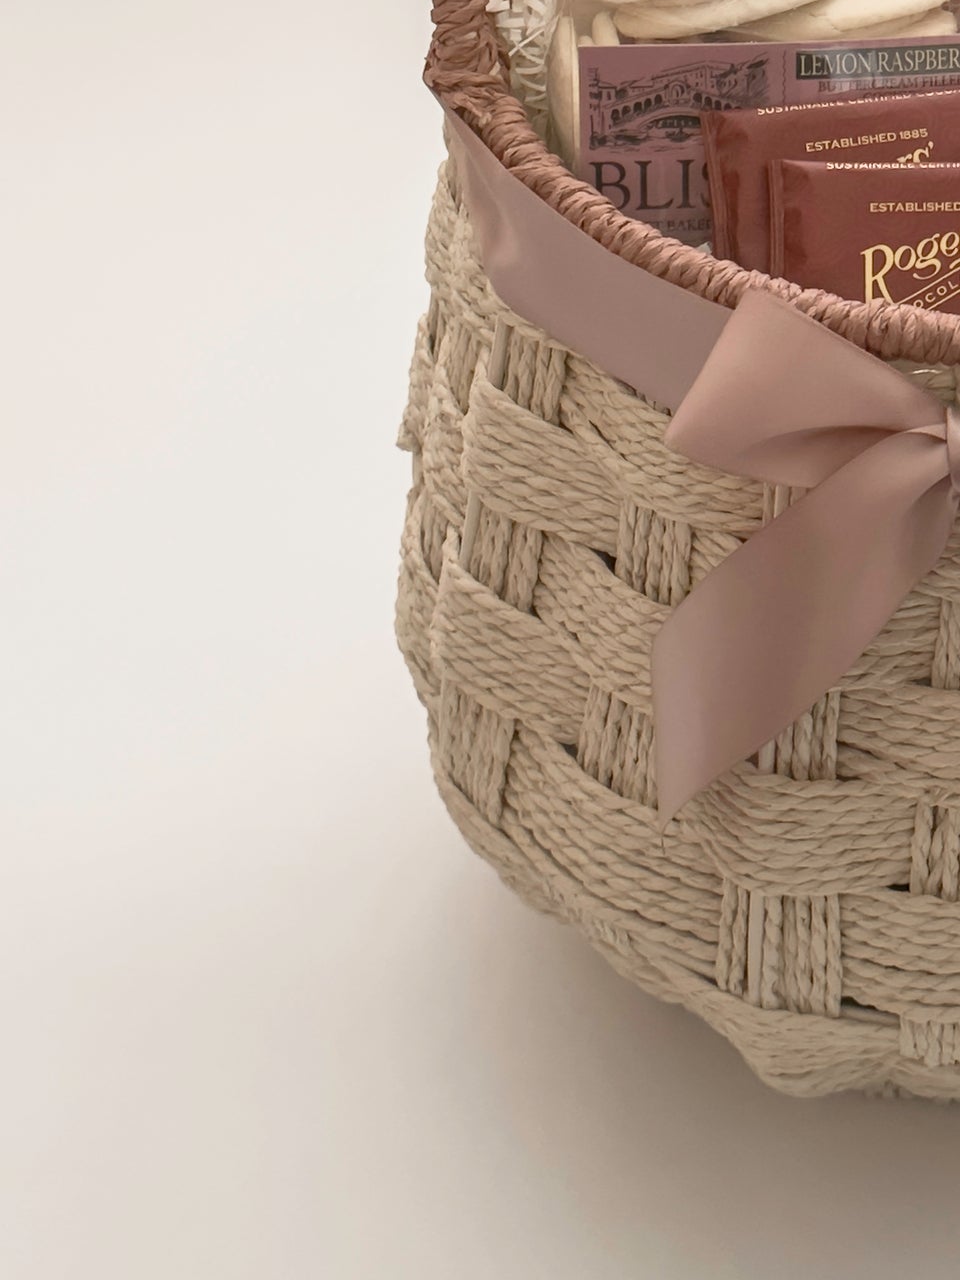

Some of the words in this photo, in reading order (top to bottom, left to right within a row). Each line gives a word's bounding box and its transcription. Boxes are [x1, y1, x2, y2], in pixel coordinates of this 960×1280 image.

[800, 52, 873, 76] LEMON
[805, 132, 896, 153] ESTABLISHED
[899, 128, 928, 141] 1885
